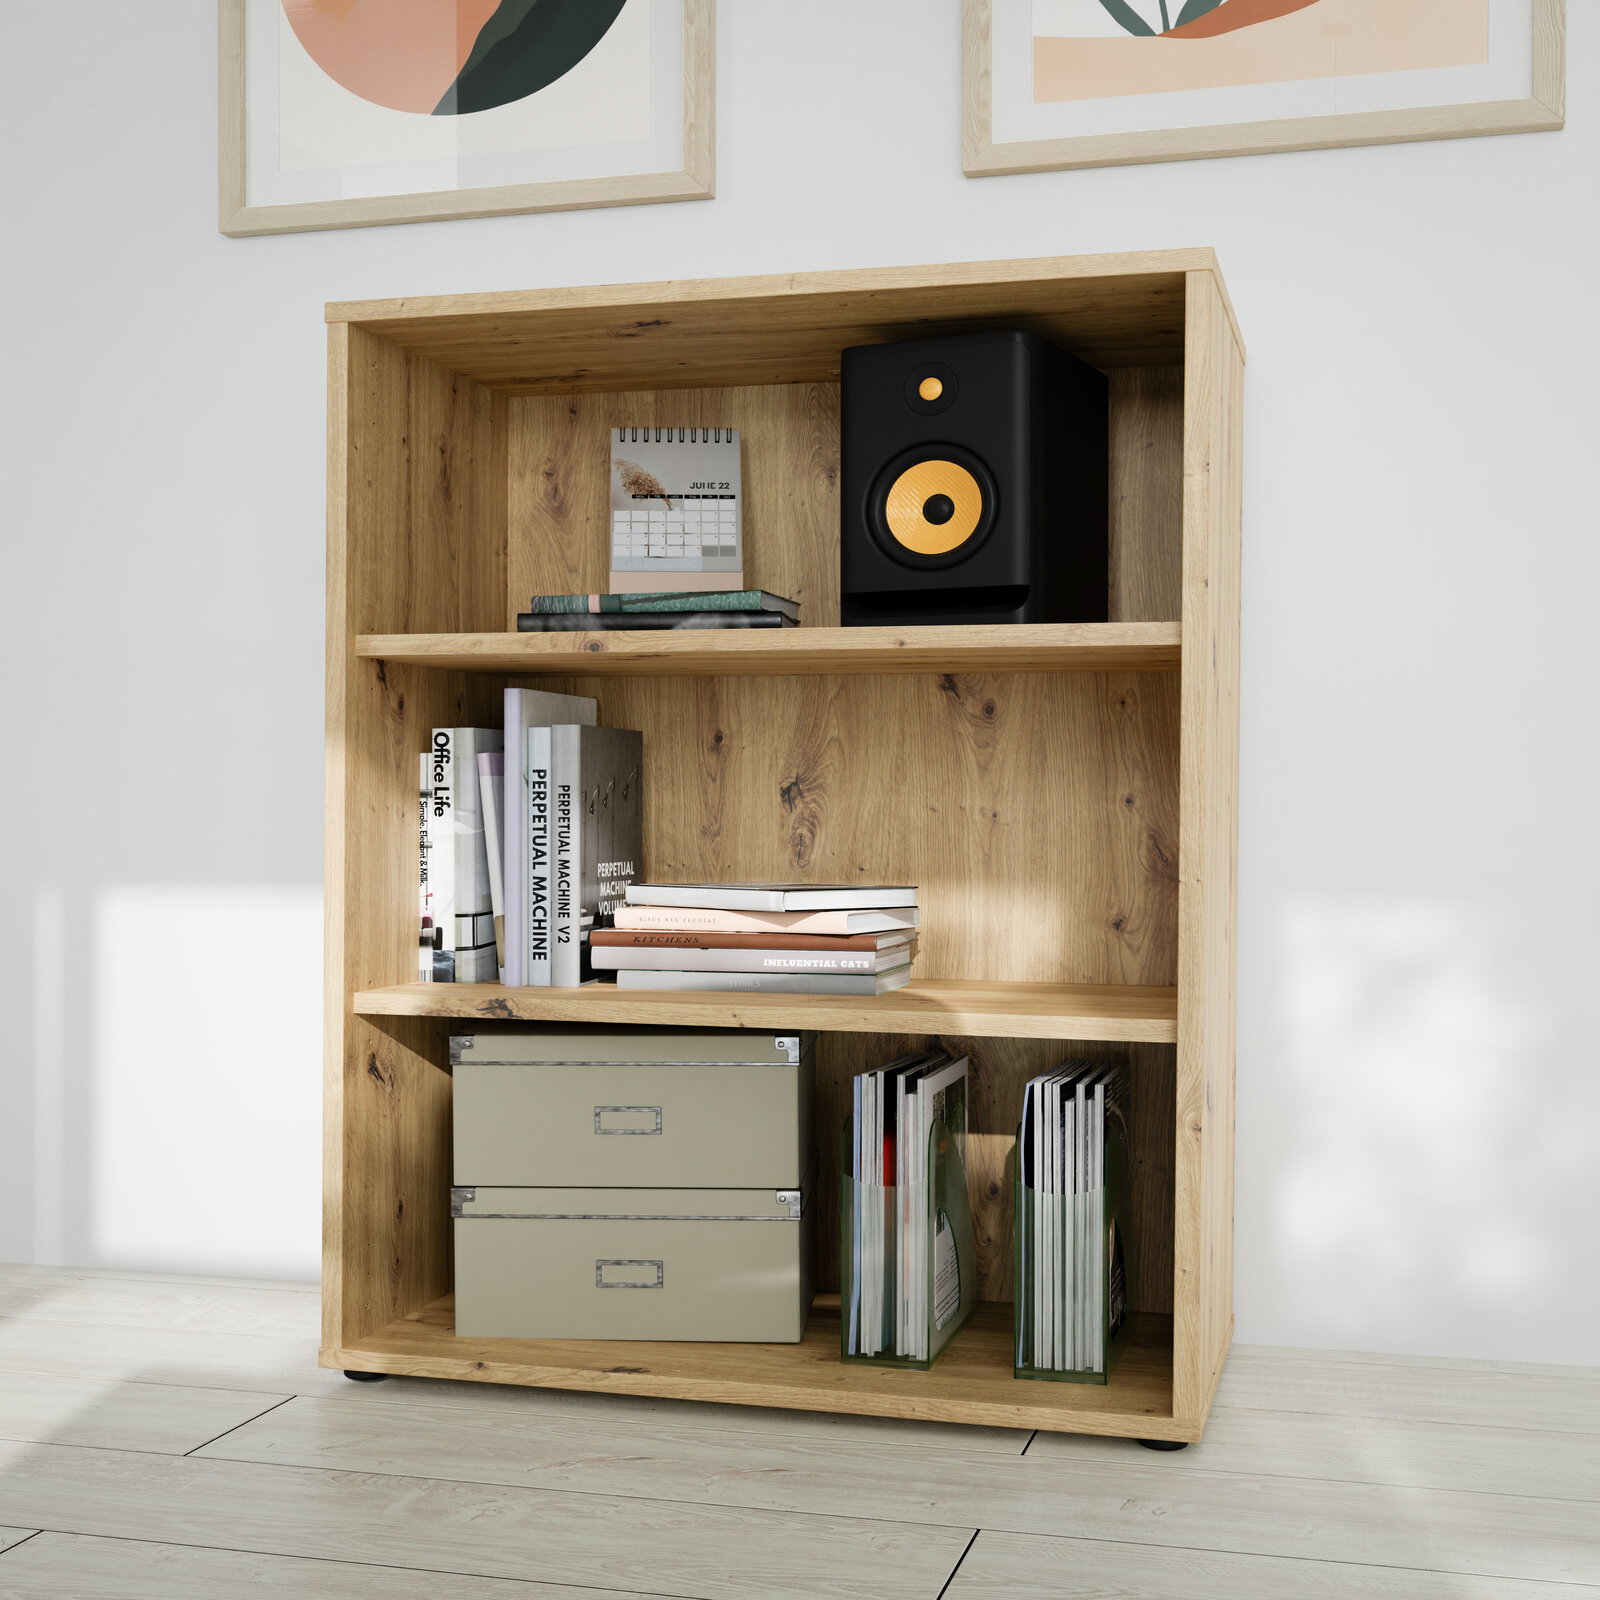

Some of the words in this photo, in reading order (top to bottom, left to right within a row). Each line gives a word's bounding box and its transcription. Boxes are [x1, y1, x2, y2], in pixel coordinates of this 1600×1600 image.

[718, 481, 730, 490] 22
[433, 731, 451, 783] Office
[433, 786, 451, 818] Life
[532, 769, 547, 870] PERPETUAL
[557, 784, 571, 856] PERPETUAL
[597, 861, 635, 878] PERPETUAL
[557, 859, 571, 919] MACHINE
[532, 875, 548, 961] MACHINE
[557, 925, 571, 944] V2
[632, 935, 700, 944] KITCHENS
[763, 958, 838, 968] INFLUENTIAL
[840, 960, 870, 969] CATS
